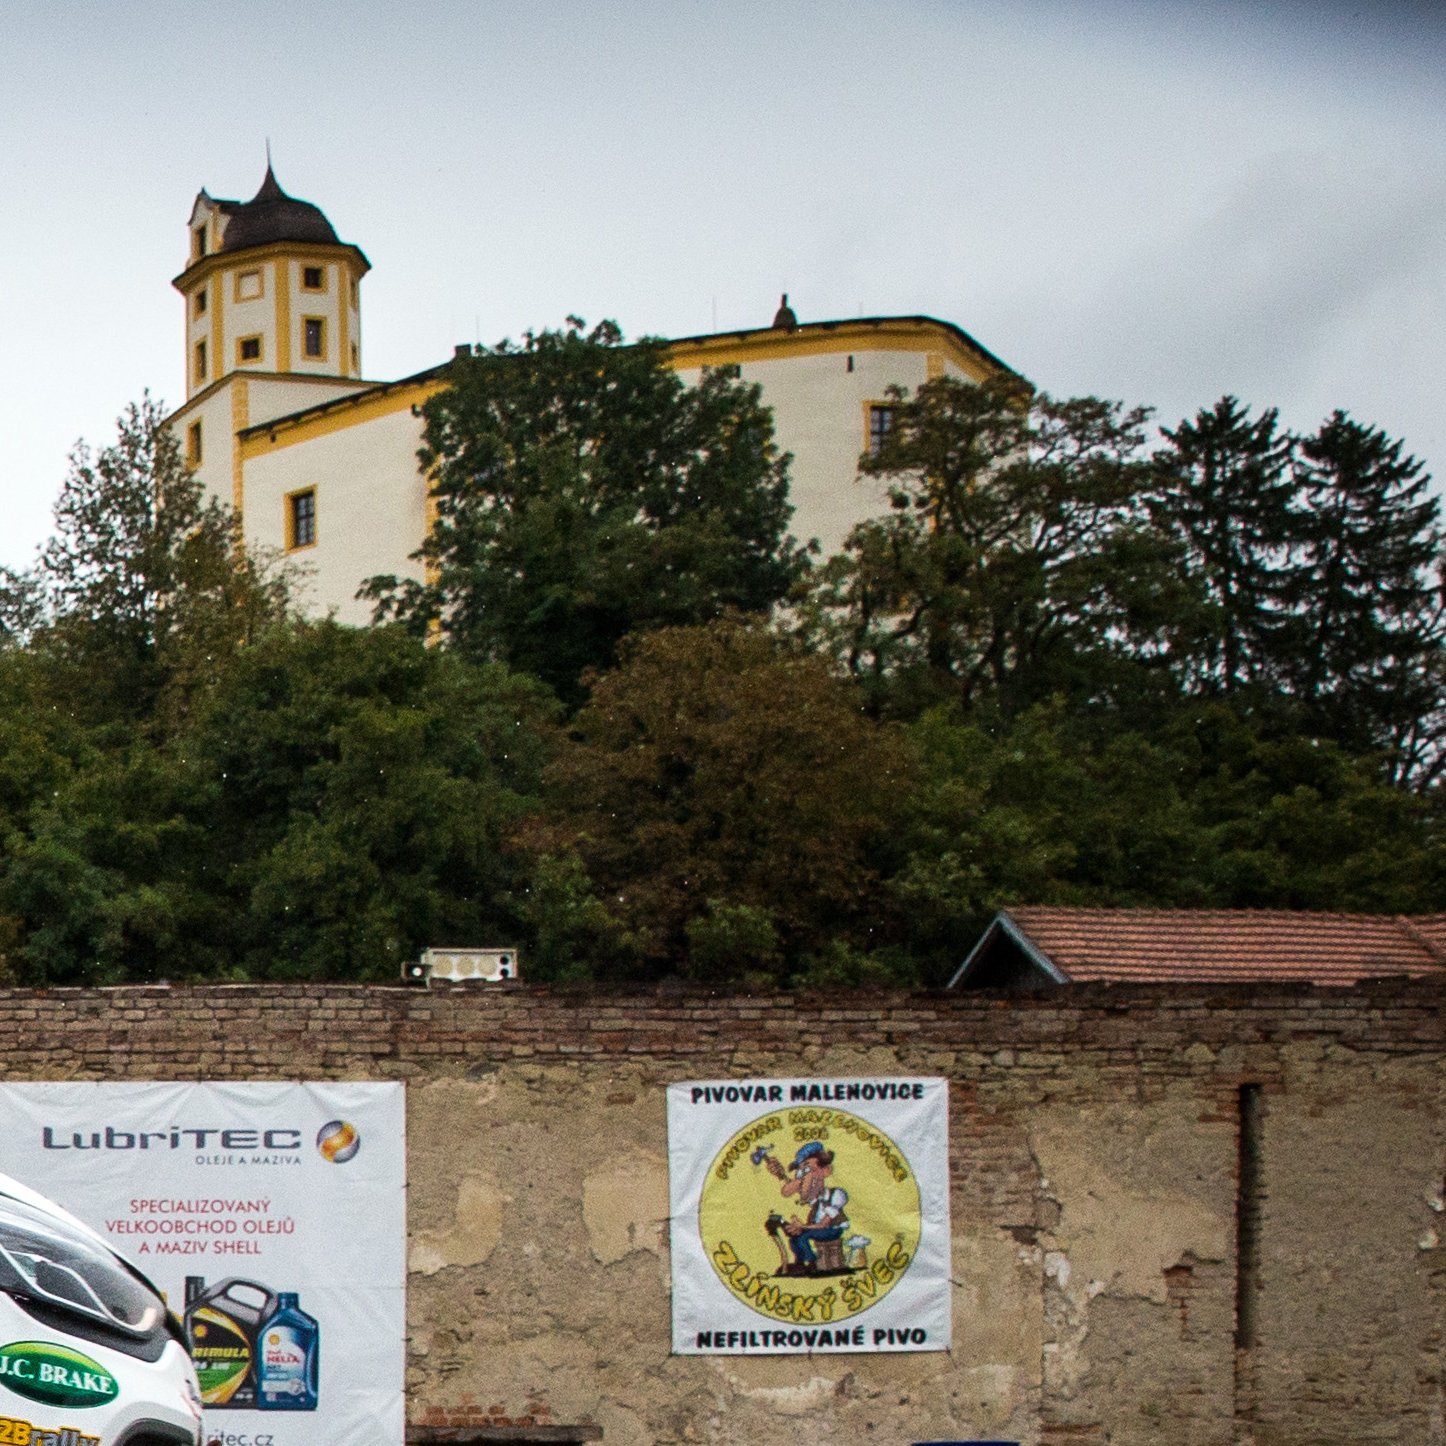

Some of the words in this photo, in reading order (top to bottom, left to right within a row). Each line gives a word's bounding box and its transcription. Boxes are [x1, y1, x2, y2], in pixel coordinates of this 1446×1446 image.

[690, 1086, 782, 1103] PIVOVAR
[790, 1083, 924, 1102] MALENOVICE
[43, 1126, 301, 1150] LubriTEC
[195, 1155, 234, 1166] OLEJE
[238, 1155, 247, 1166] A
[252, 1155, 302, 1166] MAZIVA
[105, 1220, 237, 1235] VELKOOBCHOD
[243, 1216, 295, 1236] OLEJŮ
[138, 1241, 150, 1254] A
[155, 1241, 208, 1254] MAZIV
[213, 1241, 262, 1254] SHELL
[697, 1325, 864, 1348] NEFILTROVANÉ
[872, 1328, 926, 1346] PIVO
[40, 1361, 114, 1396] BRAKE
[207, 1430, 274, 1446] ritec.cz
